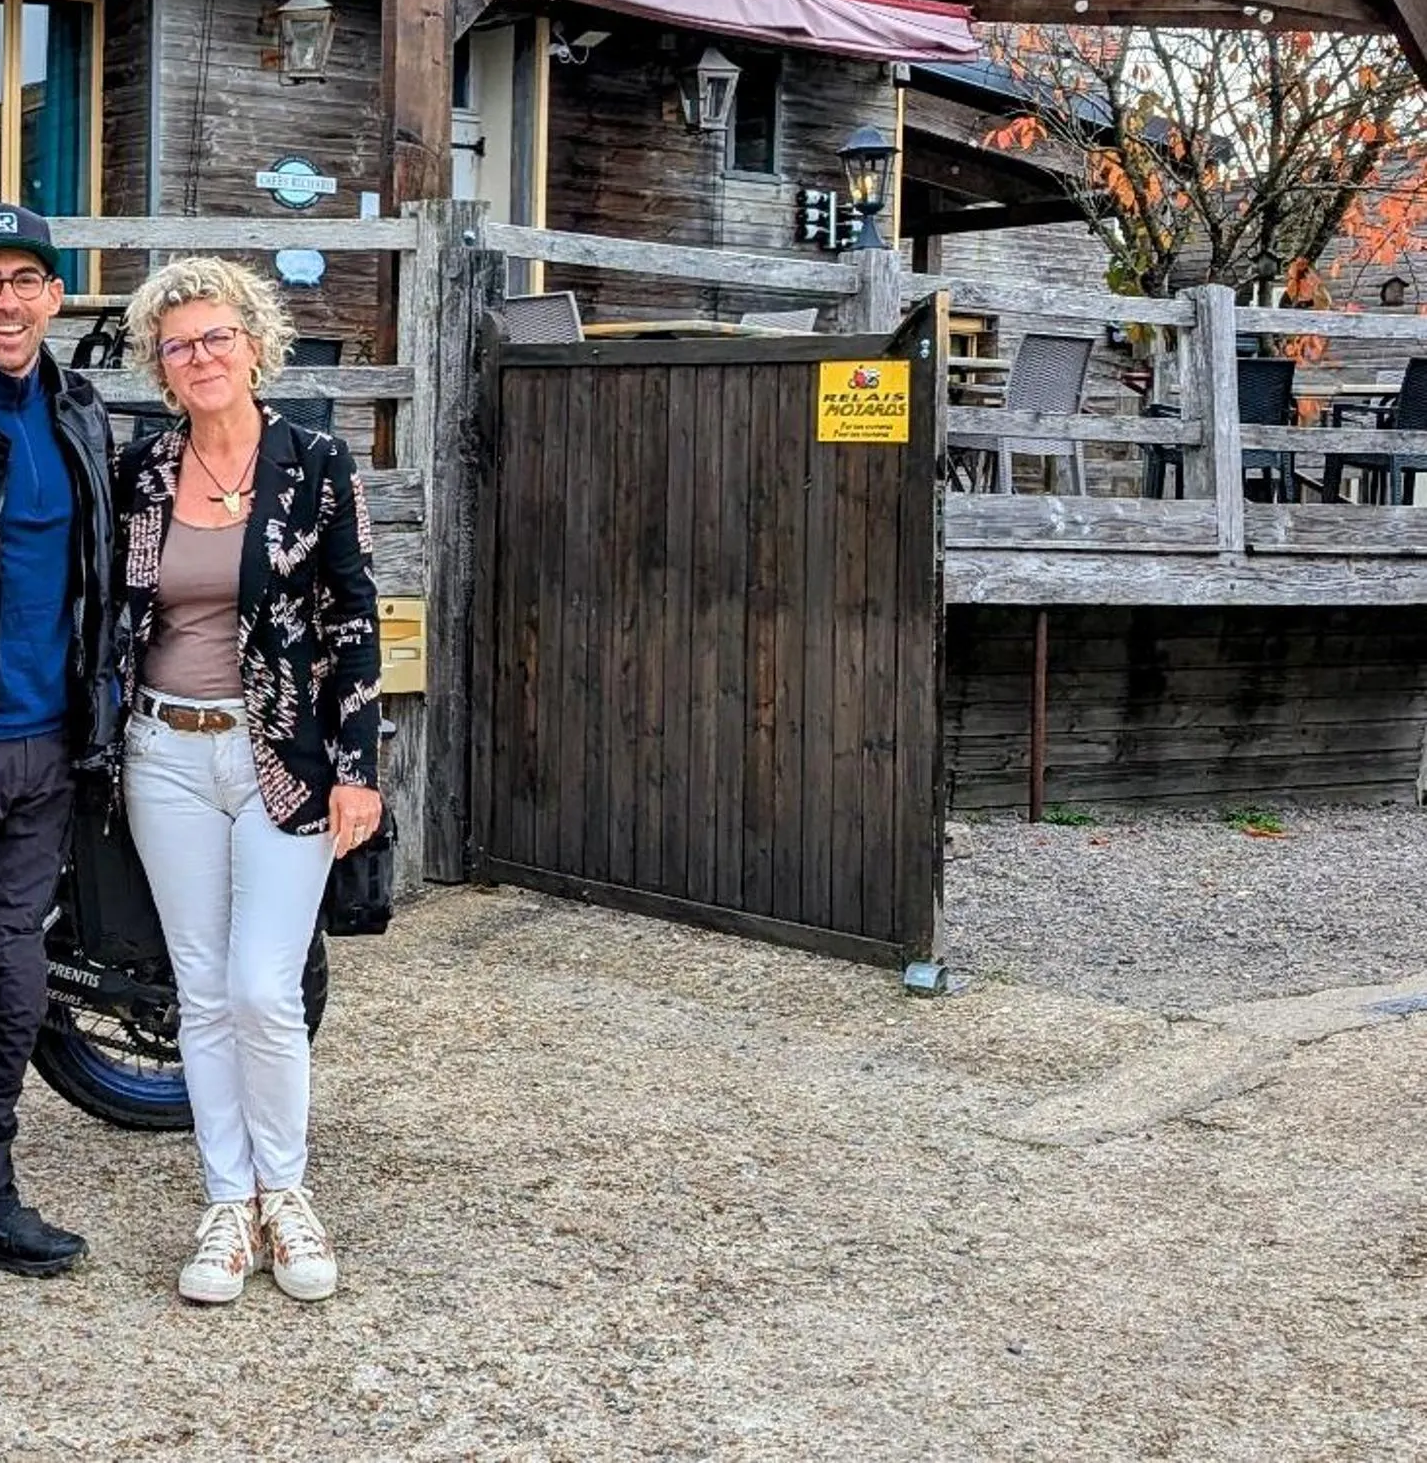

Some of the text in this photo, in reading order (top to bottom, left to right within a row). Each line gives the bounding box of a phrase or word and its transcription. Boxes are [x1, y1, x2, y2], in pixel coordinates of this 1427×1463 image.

[823, 392, 905, 403] RELAIS
[823, 403, 907, 417] MOTARDS
[45, 960, 101, 989] PRENTIS
